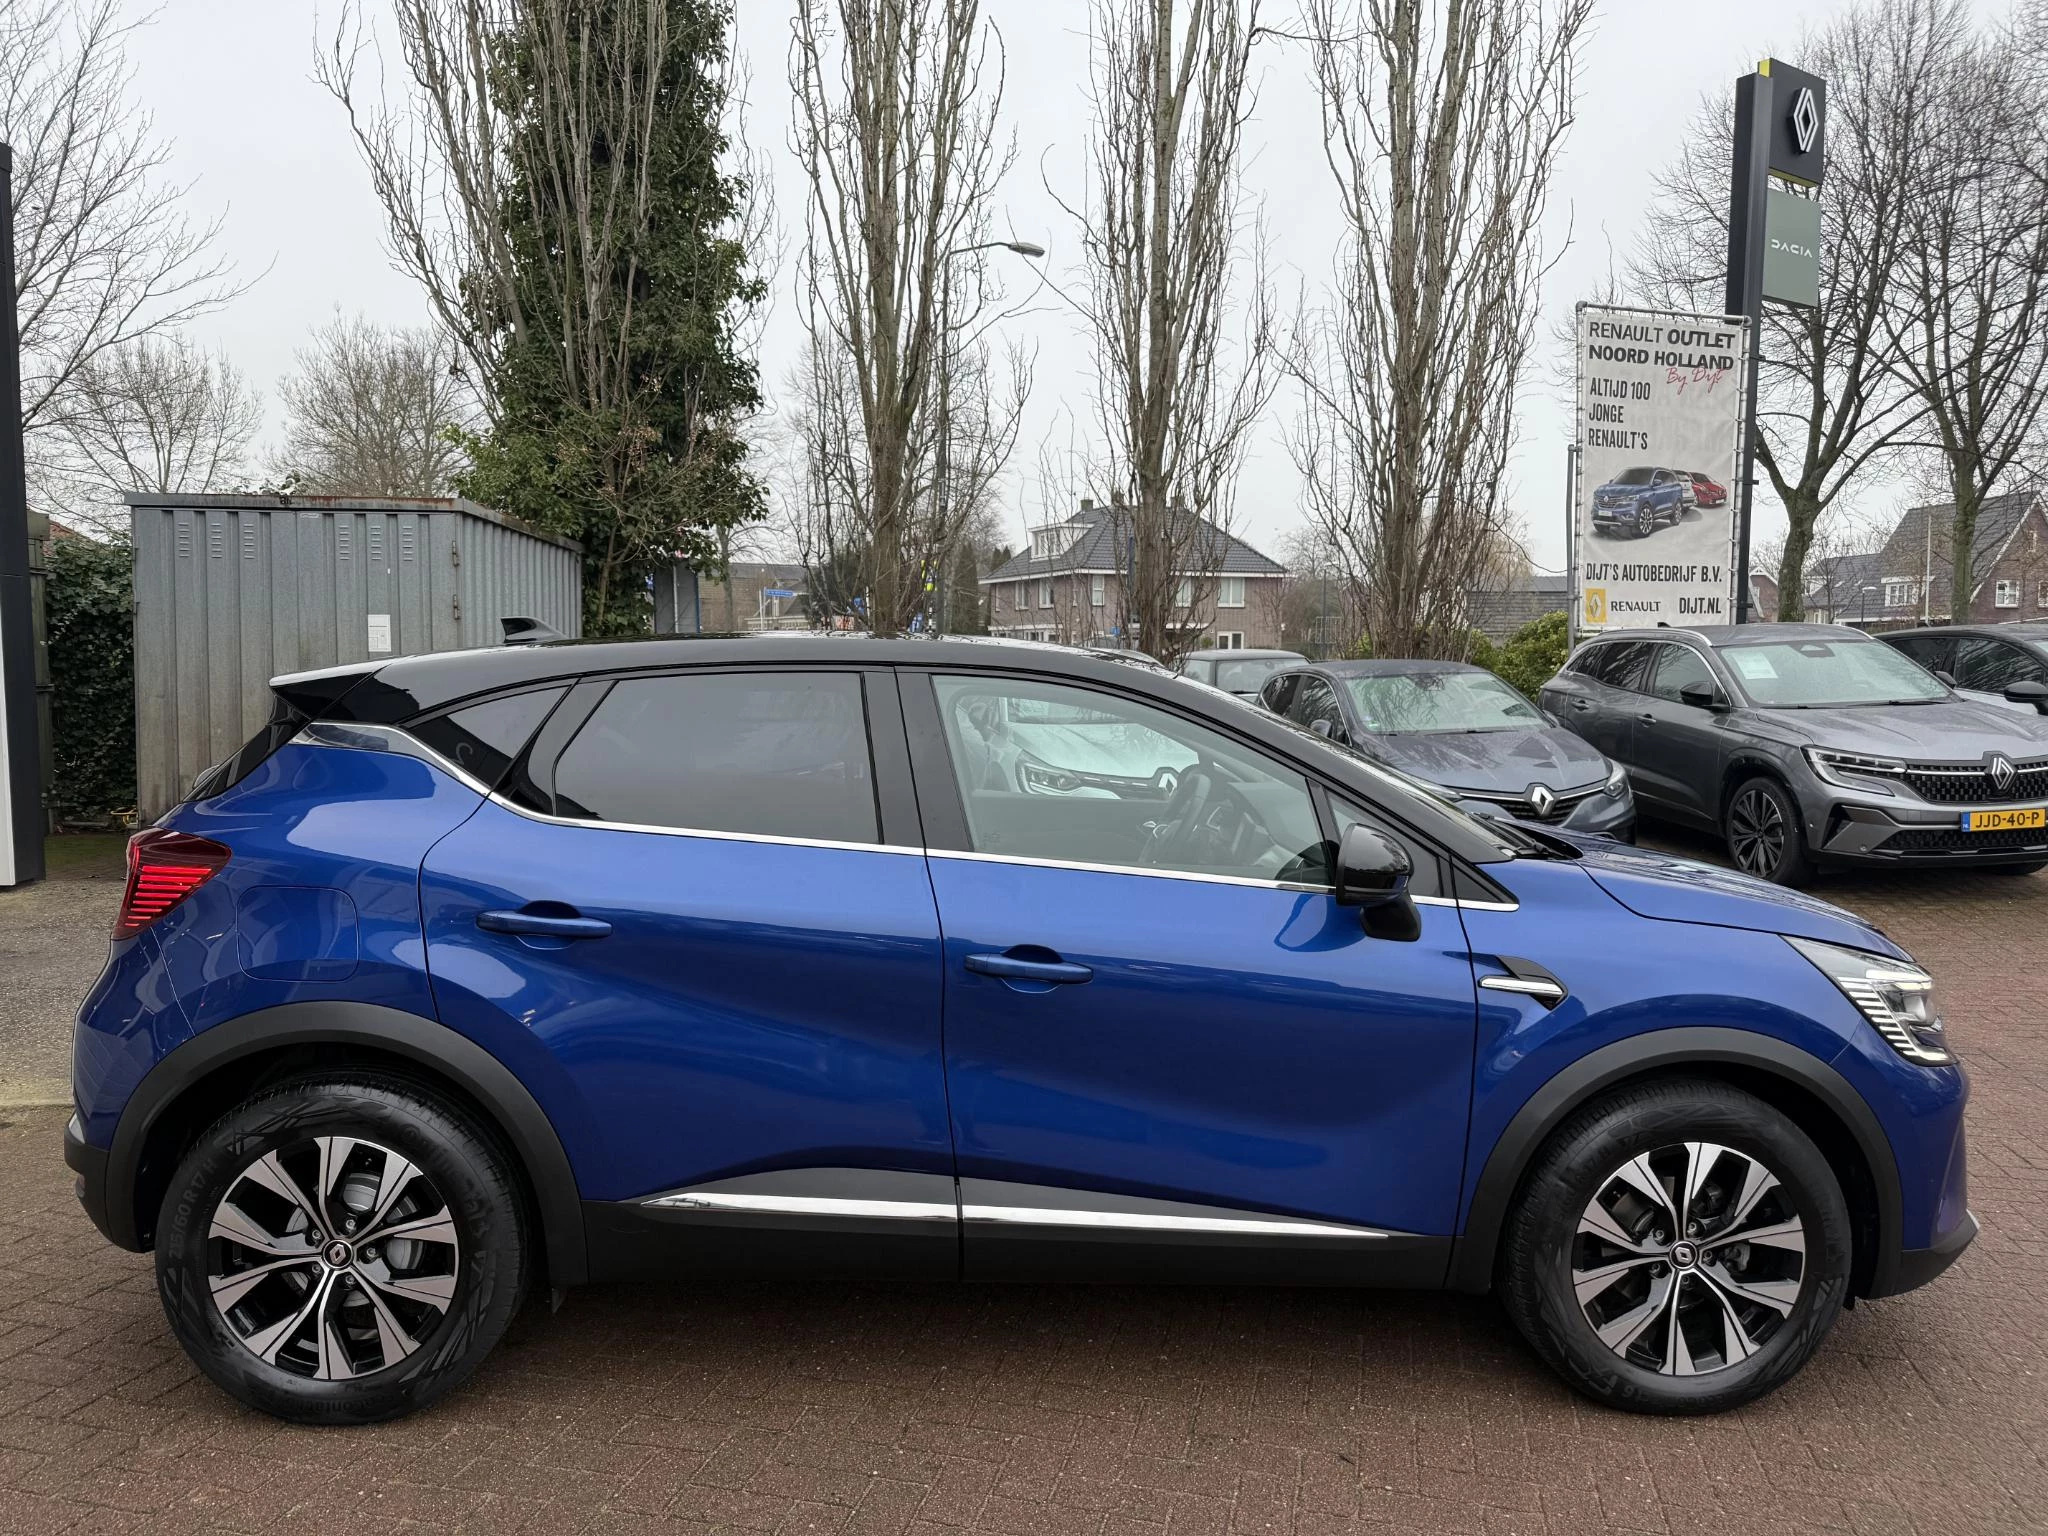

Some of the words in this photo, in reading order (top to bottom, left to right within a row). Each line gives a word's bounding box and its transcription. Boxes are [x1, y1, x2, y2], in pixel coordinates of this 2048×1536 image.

[1771, 239, 1813, 258] DACIA
[1589, 321, 1663, 343] RENAULT
[1667, 328, 1736, 349] OUTLET
[1588, 345, 1649, 364] NOORD
[1653, 350, 1734, 370] HOLLAND
[1590, 377, 1628, 398] ALTIJD
[1631, 381, 1651, 400] 100
[1666, 367, 1688, 395] By
[1589, 403, 1624, 423] JONGE
[1588, 428, 1648, 450] RENAULT'S
[1586, 563, 1619, 581] DIJT'S
[1621, 564, 1697, 582] AUTOBEDRIJF
[1701, 565, 1722, 583] B.V.
[1611, 601, 1661, 612] RENAULT
[1679, 597, 1721, 614] DIJT.NL
[1976, 812, 2039, 828] JJD-40-P
